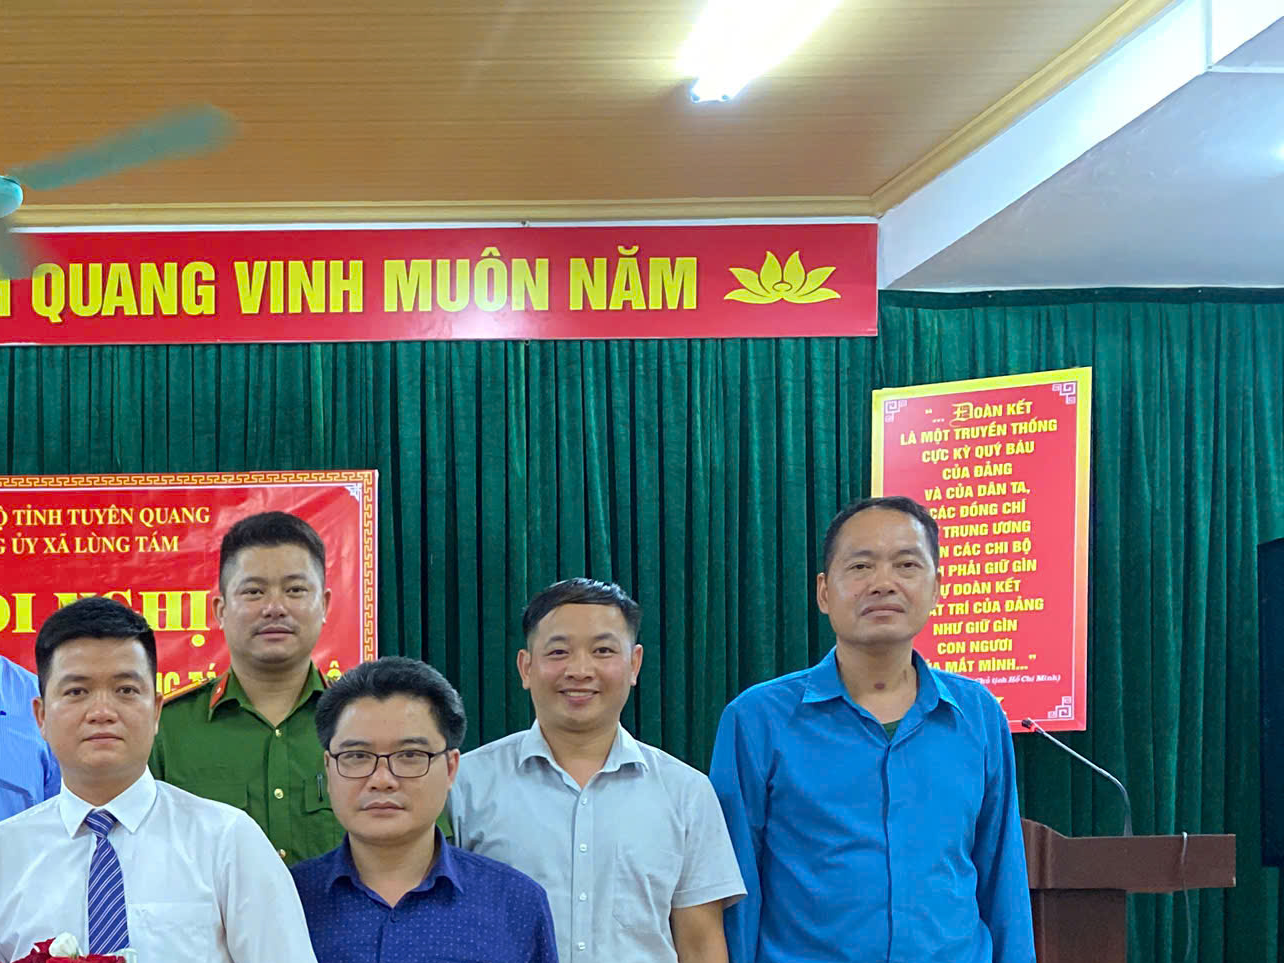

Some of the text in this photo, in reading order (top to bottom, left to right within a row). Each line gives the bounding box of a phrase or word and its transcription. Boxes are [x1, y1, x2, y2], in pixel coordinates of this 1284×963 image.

[32, 262, 216, 324] QUANG
[233, 259, 364, 316] VINH
[384, 248, 550, 312] MUÔN
[570, 245, 698, 311] NĂM
[1007, 399, 1032, 415] KẾT
[900, 430, 916, 445] LÀ
[921, 428, 950, 444] MỘT
[1011, 417, 1057, 434] THỐNG
[922, 449, 949, 464] CỰC
[975, 442, 1001, 458] QUÝ
[942, 460, 1012, 480] CỦA ĐẢNG
[925, 481, 1030, 500] VÀ CỦA DÂN TA,
[13, 504, 62, 526] TỈNH
[67, 505, 133, 525] TUYÊN
[139, 507, 210, 527] QUANG
[930, 506, 956, 519] CÁC
[1002, 499, 1026, 514] CHÍ
[943, 520, 1031, 538] TRUNG ƯƠNG
[12, 533, 38, 554] ỦY
[43, 533, 70, 553] XÃ
[75, 532, 131, 553] LÙNG
[135, 532, 179, 553] TÁM
[953, 542, 981, 556] CÁC
[985, 541, 1008, 554] CHI
[1012, 538, 1031, 554] BỘ
[948, 560, 980, 577] PHẢI
[985, 559, 1009, 574] GIỮ
[1012, 558, 1037, 572] GÌN
[954, 580, 991, 596] ĐOÀN
[996, 577, 1021, 592] KẾT
[948, 602, 969, 615] TRÍ
[973, 598, 1001, 614] CỦA
[1004, 596, 1044, 611] ĐẢNG
[933, 617, 1018, 635] NHƯ GIỮ GÌN
[938, 641, 965, 654] CON
